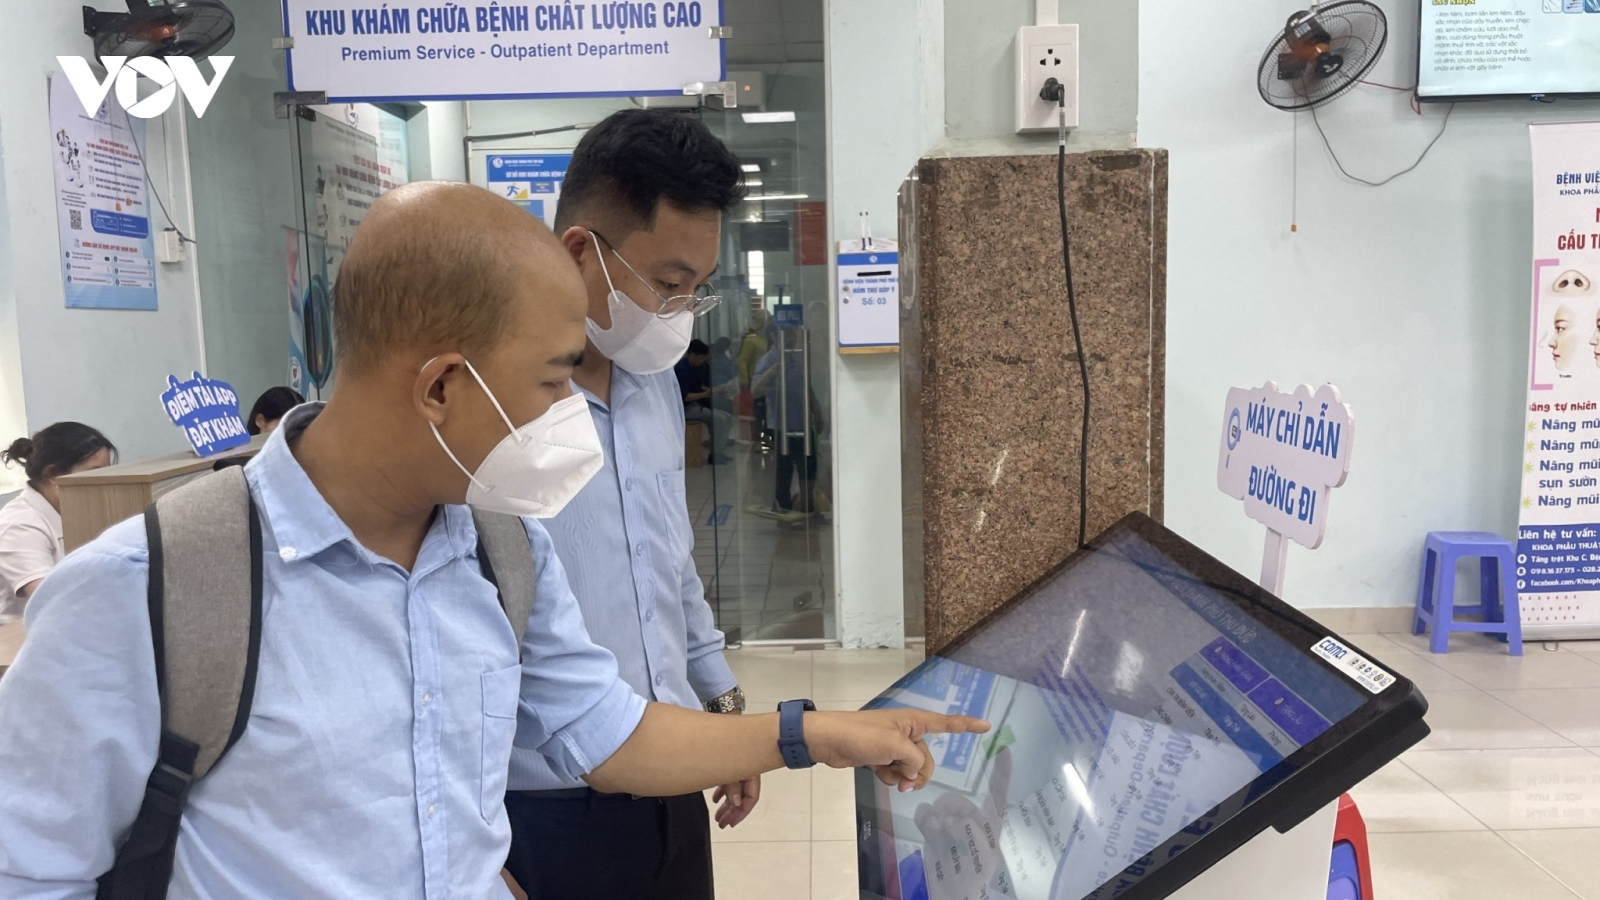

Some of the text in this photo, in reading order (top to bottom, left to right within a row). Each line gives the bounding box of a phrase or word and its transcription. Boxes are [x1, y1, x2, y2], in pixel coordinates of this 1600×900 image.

[306, 10, 346, 35] KHU
[352, 3, 411, 35] KHÁM
[417, 2, 470, 34] CHỮA
[476, 1, 529, 38] BỆNH
[592, 1, 657, 35] LƯỢNG
[663, 1, 702, 28] CAO
[341, 46, 411, 61] Premium
[416, 45, 476, 60] Service
[491, 43, 572, 61] Outpatient
[577, 41, 670, 59] Department
[1556, 172, 1581, 187] BỆNH
[1558, 228, 1586, 251] CẤU
[862, 297, 886, 306] Số: 03
[168, 382, 200, 421] ĐIỂM
[213, 386, 236, 406] APP
[1529, 401, 1597, 413] áng tự nhiên
[188, 411, 246, 452] ĐẶT KHÁM
[1246, 397, 1341, 459] MÁY CHỈ DẪN
[1541, 419, 1576, 433] Nâng
[1540, 439, 1600, 453] Nâng mũ
[1539, 460, 1574, 474] Nâng
[1539, 475, 1597, 491] sụn sườn
[1248, 465, 1317, 525] ĐƯỜNG ĐI
[1538, 493, 1600, 509] Nâng mũi
[1518, 527, 1597, 541] Liên hệ tư vấn:
[1556, 541, 1576, 550] PHẪU
[1531, 555, 1549, 564] Tầng
[1566, 554, 1579, 562] Khu
